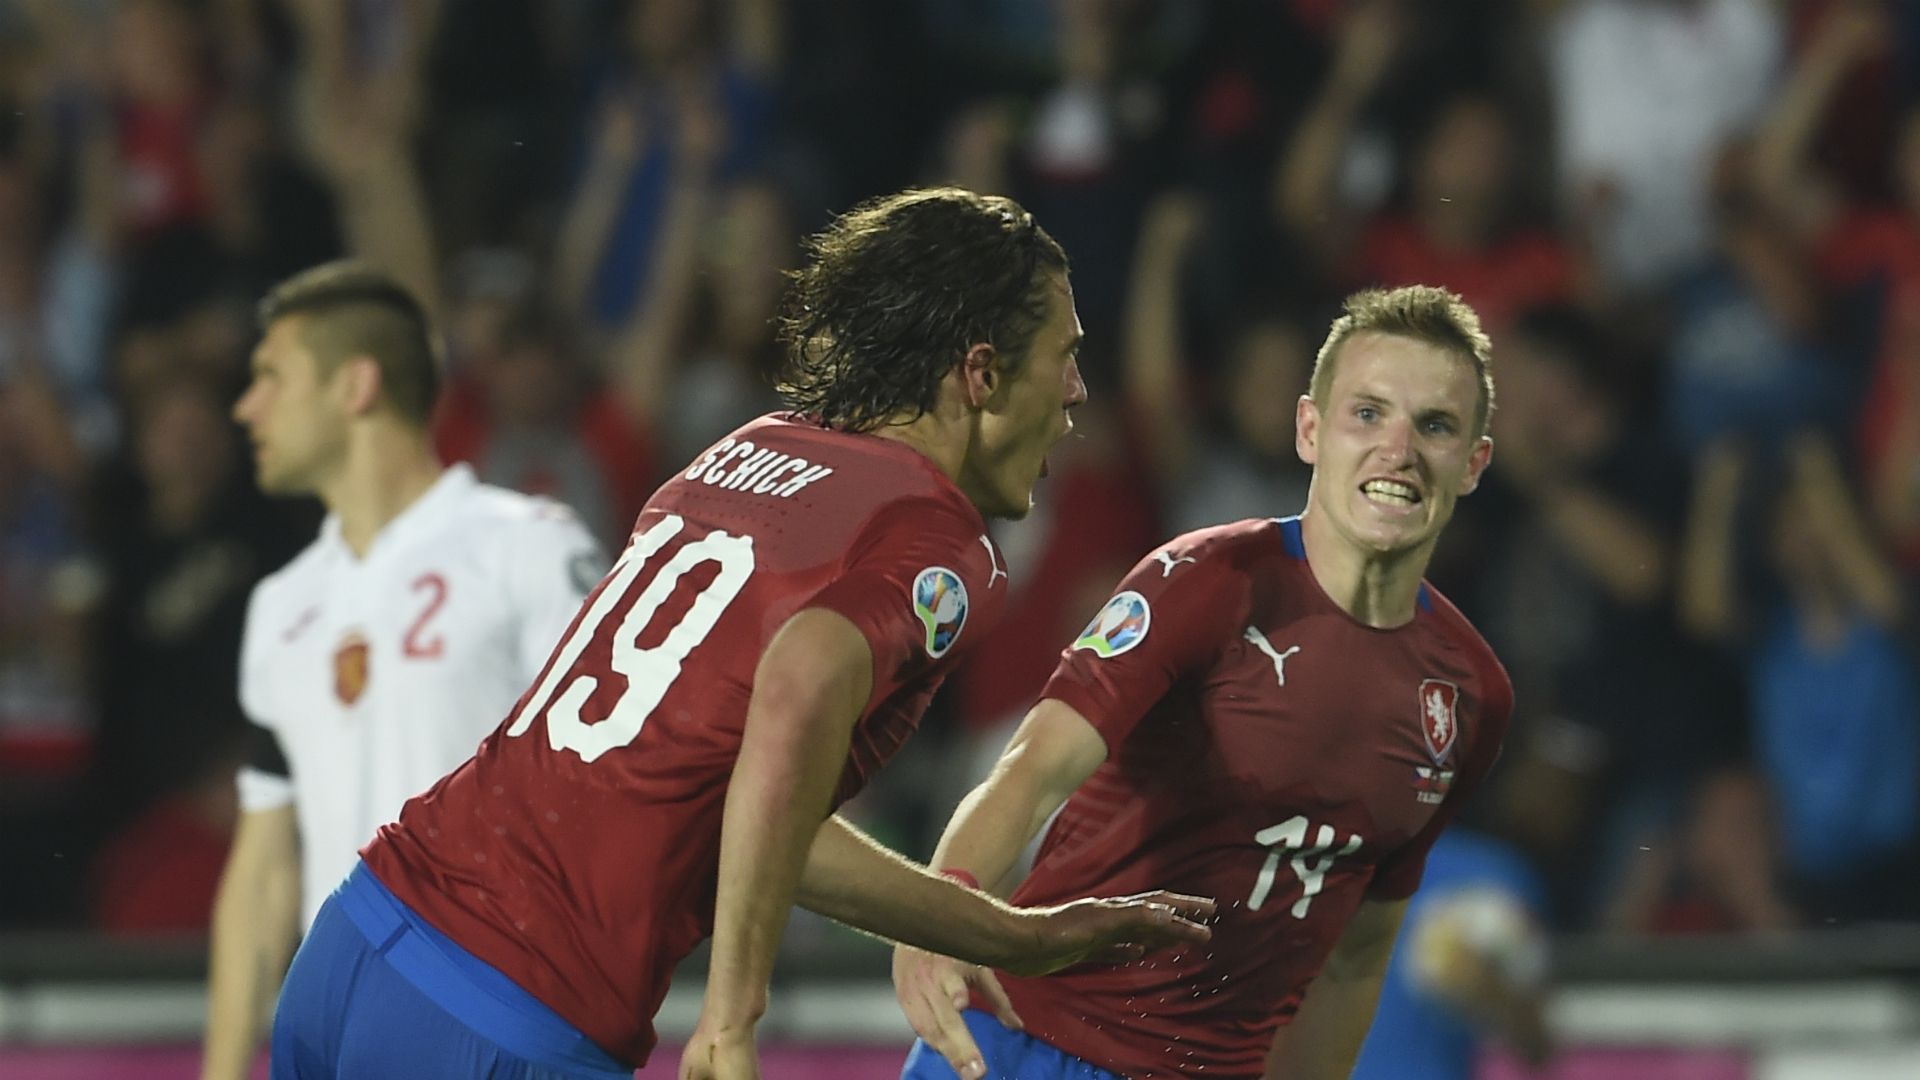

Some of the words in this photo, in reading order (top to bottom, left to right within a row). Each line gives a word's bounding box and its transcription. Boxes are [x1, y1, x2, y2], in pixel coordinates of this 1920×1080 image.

[685, 438, 833, 498] SCHICK
[402, 571, 449, 659] 2
[506, 514, 755, 763] 19
[1247, 815, 1363, 919] 14
